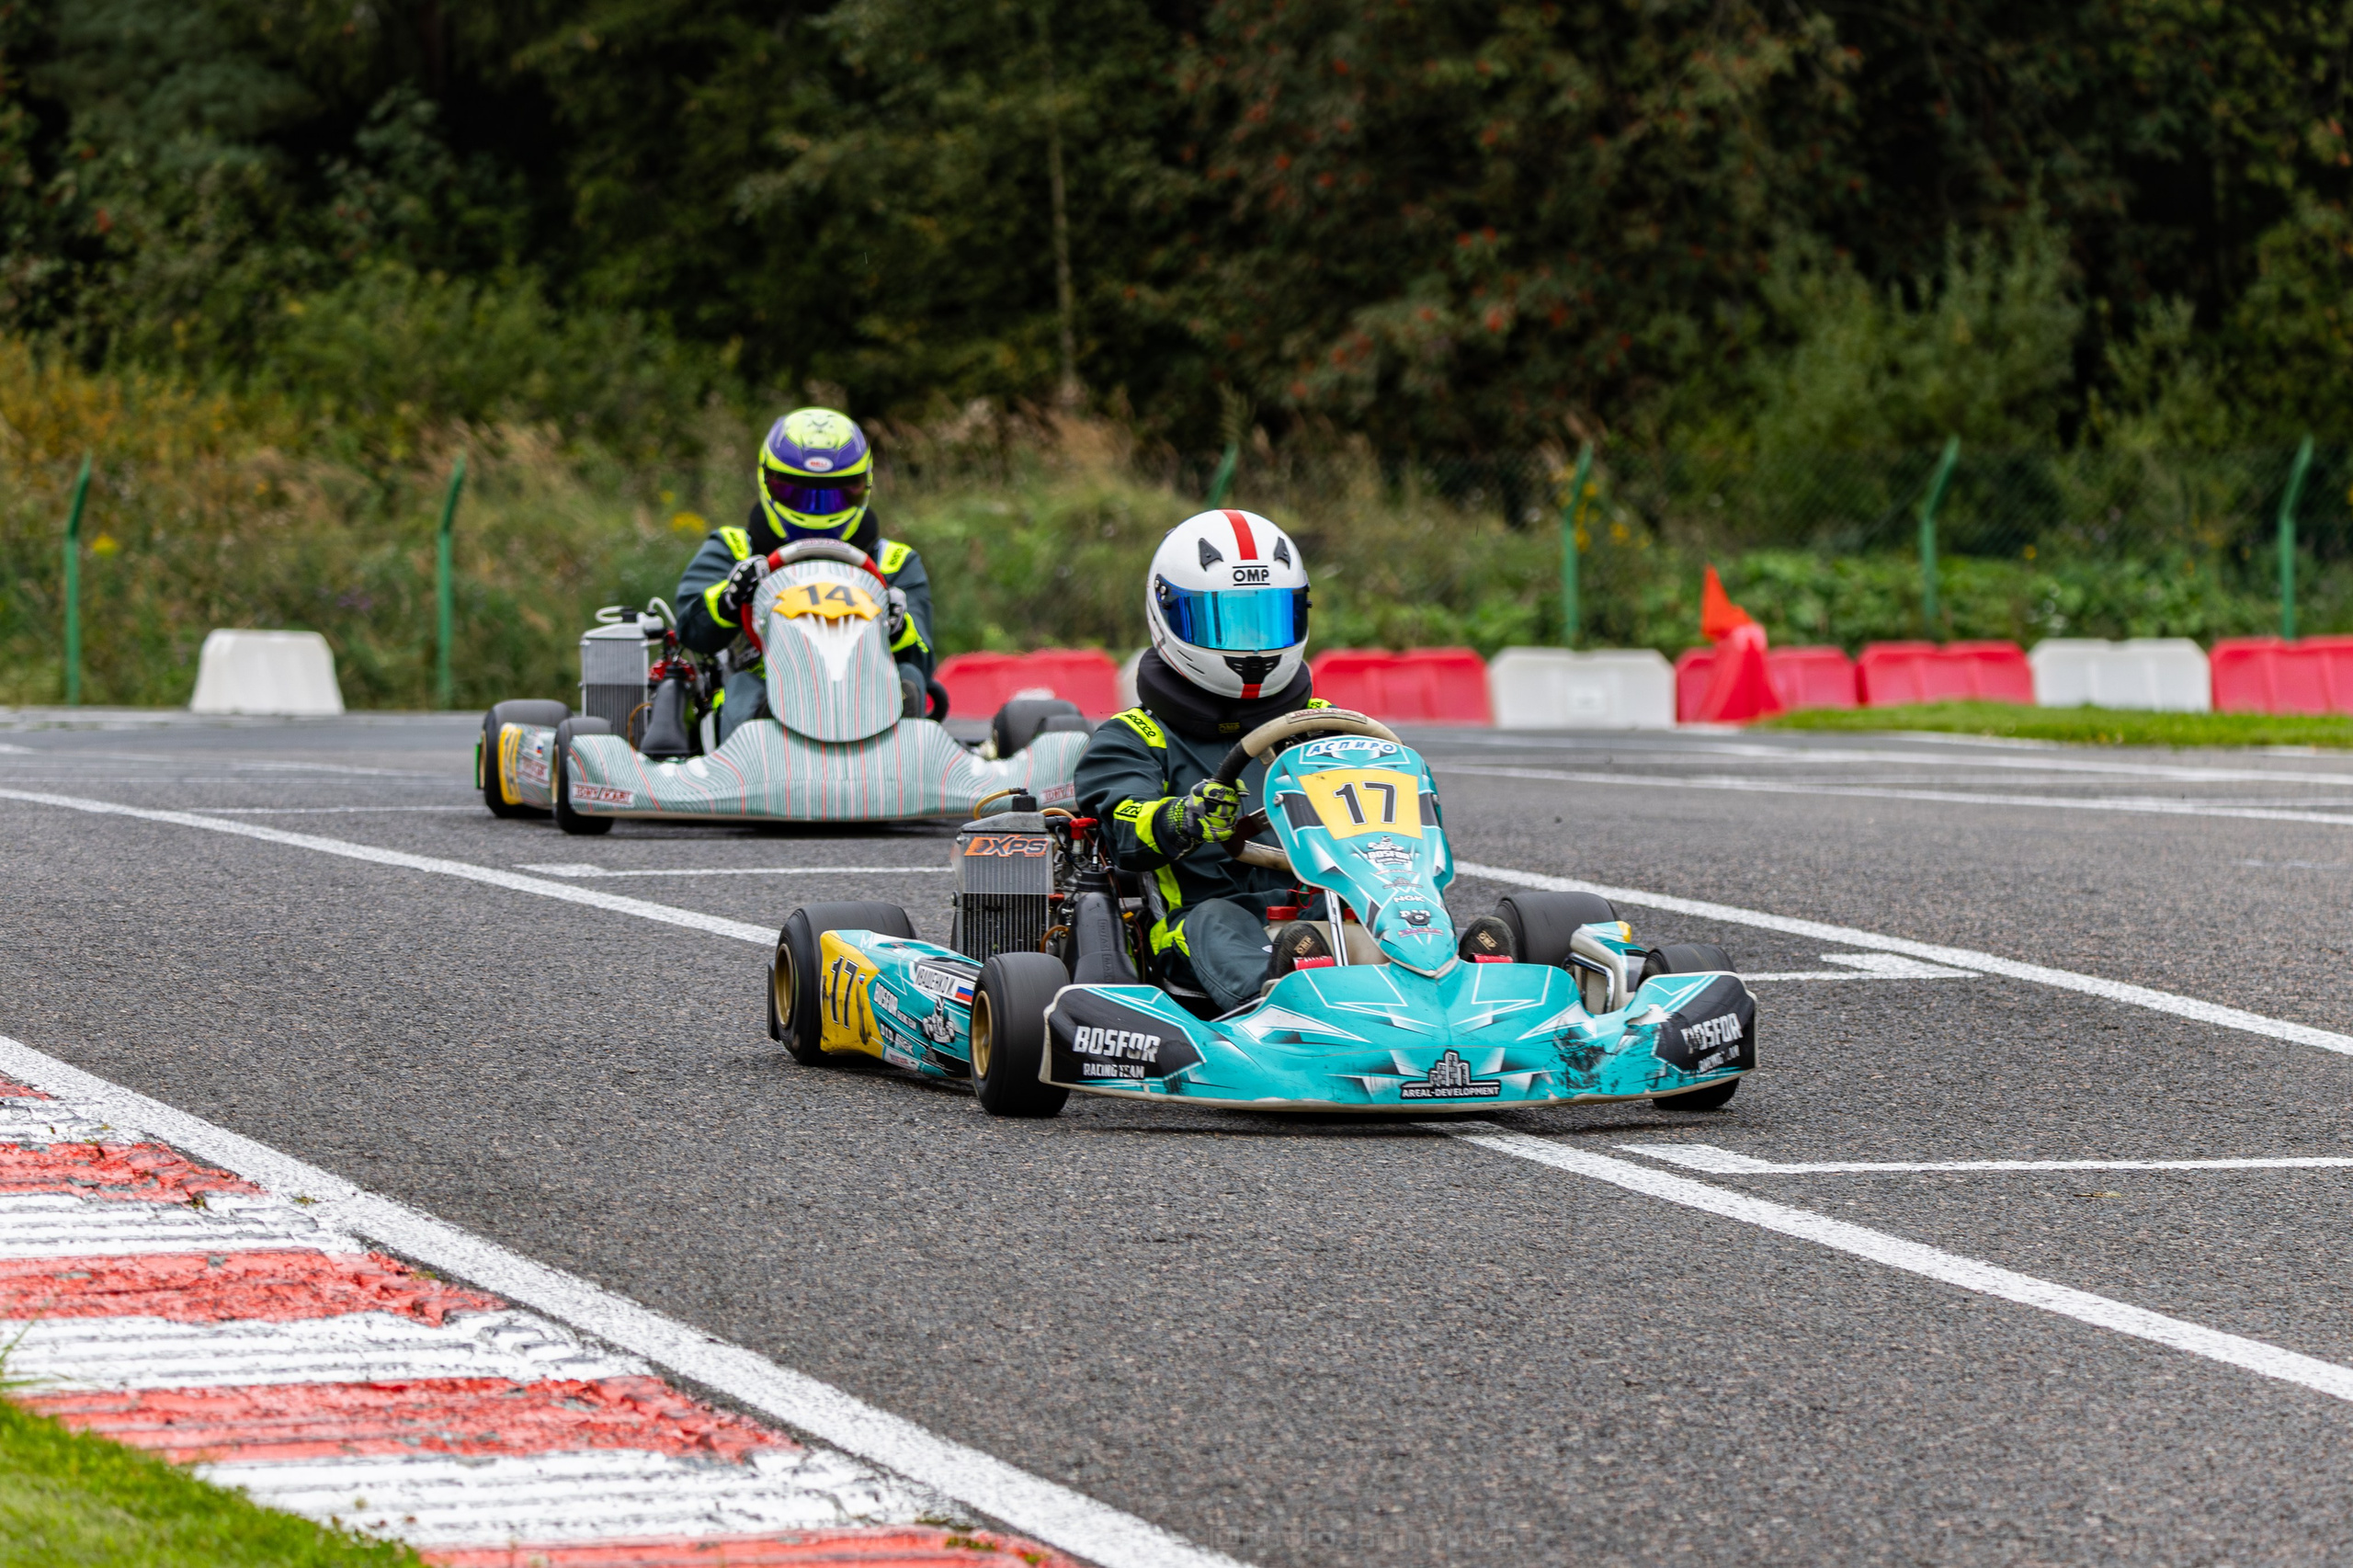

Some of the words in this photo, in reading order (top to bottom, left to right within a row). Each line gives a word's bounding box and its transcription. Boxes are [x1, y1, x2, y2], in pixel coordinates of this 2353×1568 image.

[1233, 568, 1270, 583] OMP
[800, 585, 857, 608] 14
[1126, 713, 1156, 738] sparco
[1310, 741, 1394, 755] АСПИРО
[1332, 780, 1398, 826] 17
[986, 835, 1049, 857] XPS
[1393, 895, 1426, 903] NGK
[1295, 936, 1314, 956] OMP
[1478, 932, 1496, 949] OMP
[831, 955, 859, 1029] 17
[1073, 1025, 1162, 1062] BOSFOR
[1083, 1062, 1118, 1077] RACING
[1118, 1064, 1145, 1079] TEAM
[1402, 1086, 1500, 1098] AREAL-DEVELOPMENT
